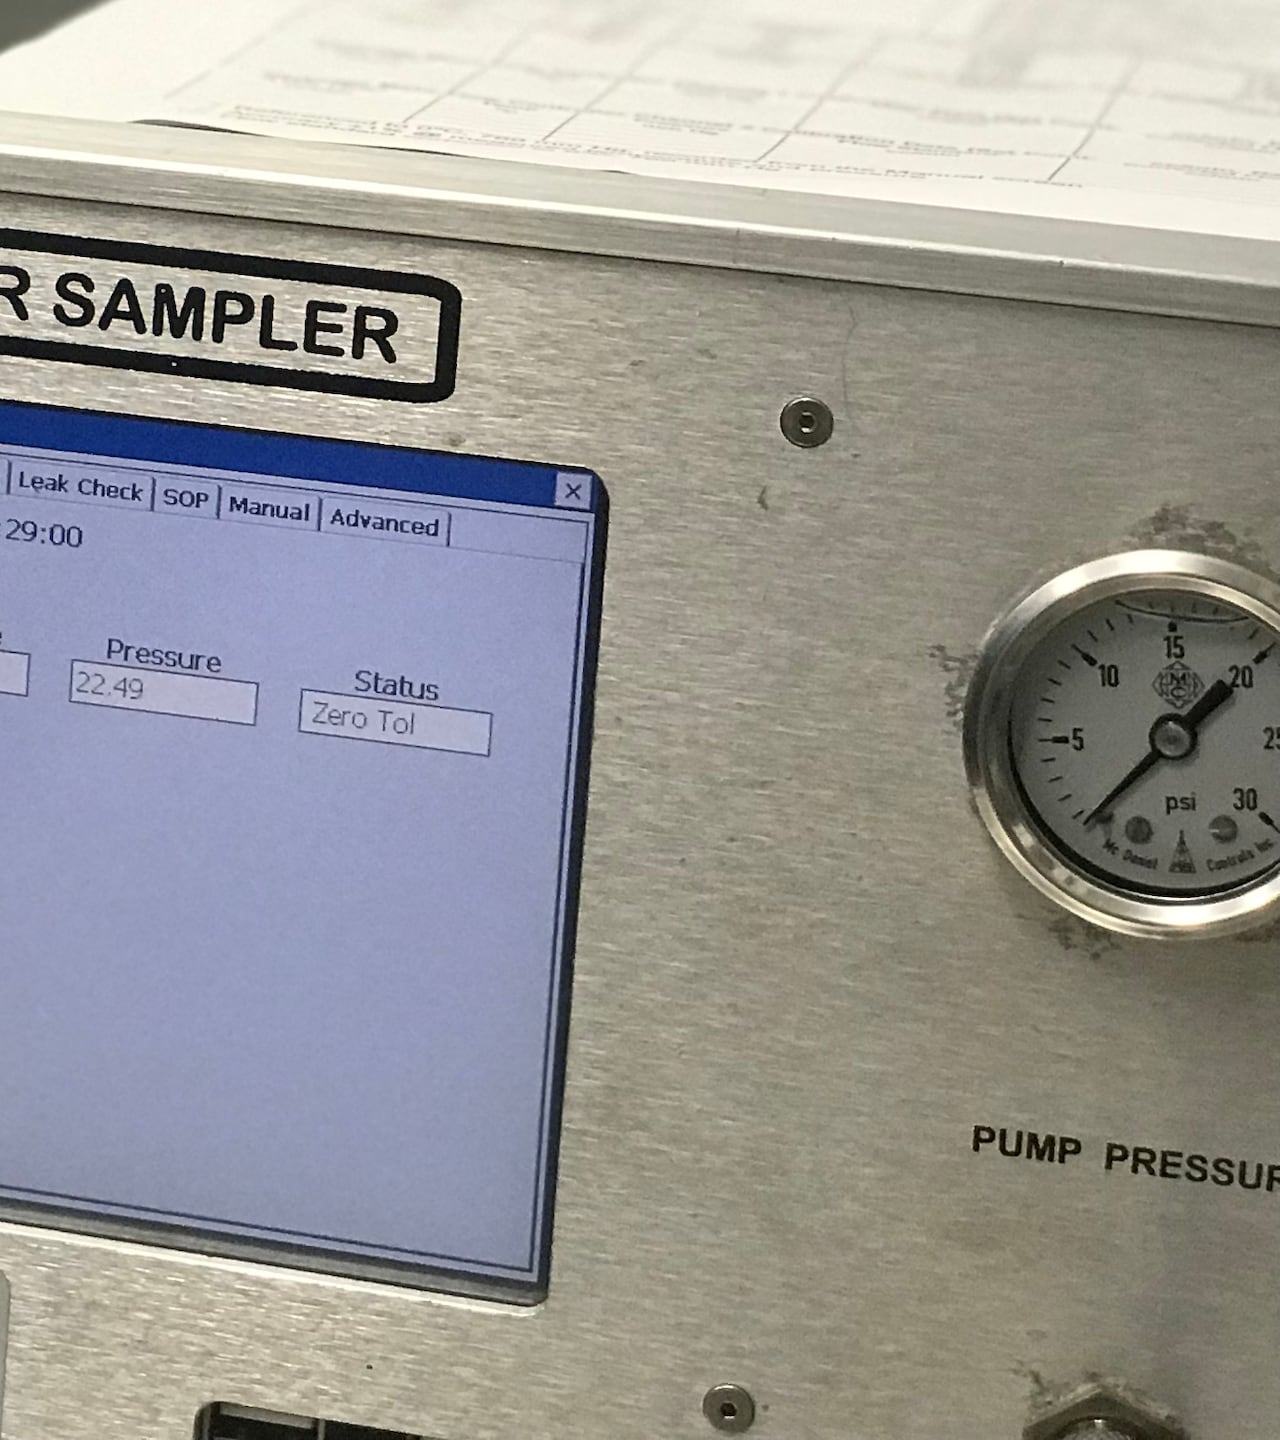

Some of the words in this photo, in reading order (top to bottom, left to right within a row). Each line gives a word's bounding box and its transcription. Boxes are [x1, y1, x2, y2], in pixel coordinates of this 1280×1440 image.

[53, 273, 400, 365] SAMPLER
[19, 471, 69, 494] Leak
[77, 478, 143, 502] Check
[163, 488, 209, 509] SOP
[229, 496, 311, 522] Manual
[330, 508, 439, 538] Advanced
[107, 637, 223, 673] Pressure
[1163, 635, 1185, 659] 15
[75, 671, 144, 700] 22.49
[354, 669, 440, 701] Status
[1098, 664, 1120, 688] 10
[1228, 664, 1254, 689] 20
[312, 701, 368, 731] Zero
[378, 709, 416, 736] Tol
[1071, 728, 1085, 751] 5
[1164, 792, 1197, 814] psi
[1233, 787, 1258, 811] 30
[972, 1125, 1082, 1164] PUMP
[1104, 1142, 1280, 1192] PRESSUR
